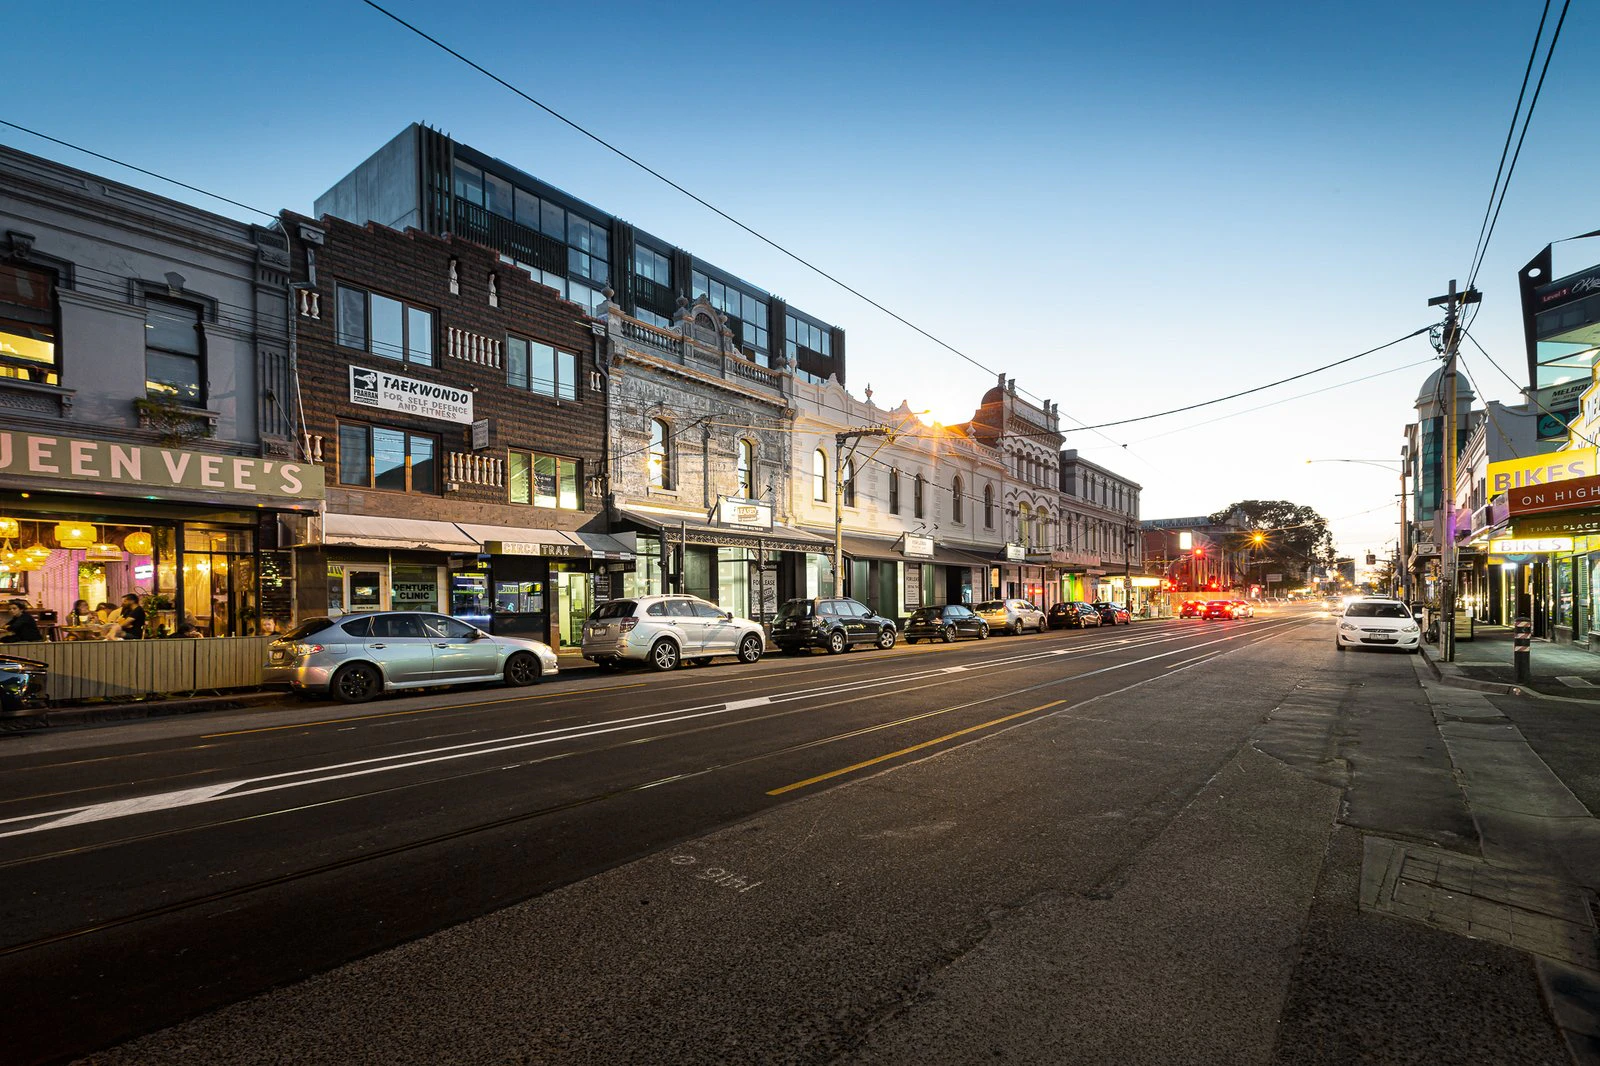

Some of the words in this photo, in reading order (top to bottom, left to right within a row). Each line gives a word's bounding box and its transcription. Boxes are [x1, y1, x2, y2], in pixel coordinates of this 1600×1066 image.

[1543, 290, 1561, 302] Level
[382, 376, 469, 404] TAEKWONDO
[383, 391, 403, 402] FOR
[408, 397, 428, 407] SELF
[432, 401, 468, 415] DEFENCE
[397, 402, 418, 412] AND
[421, 407, 457, 419] FITNESS
[161, 451, 304, 495] VEE'S
[1494, 461, 1586, 492] BIKES
[1521, 494, 1545, 506] ON
[1555, 485, 1600, 501] HIGH
[1563, 522, 1599, 531] PLACE
[502, 542, 540, 554] CIRCA
[541, 544, 570, 556] TRAX
[1501, 539, 1562, 552] BIKES
[394, 583, 435, 592] DENTURE
[399, 591, 430, 600] CLINIC
